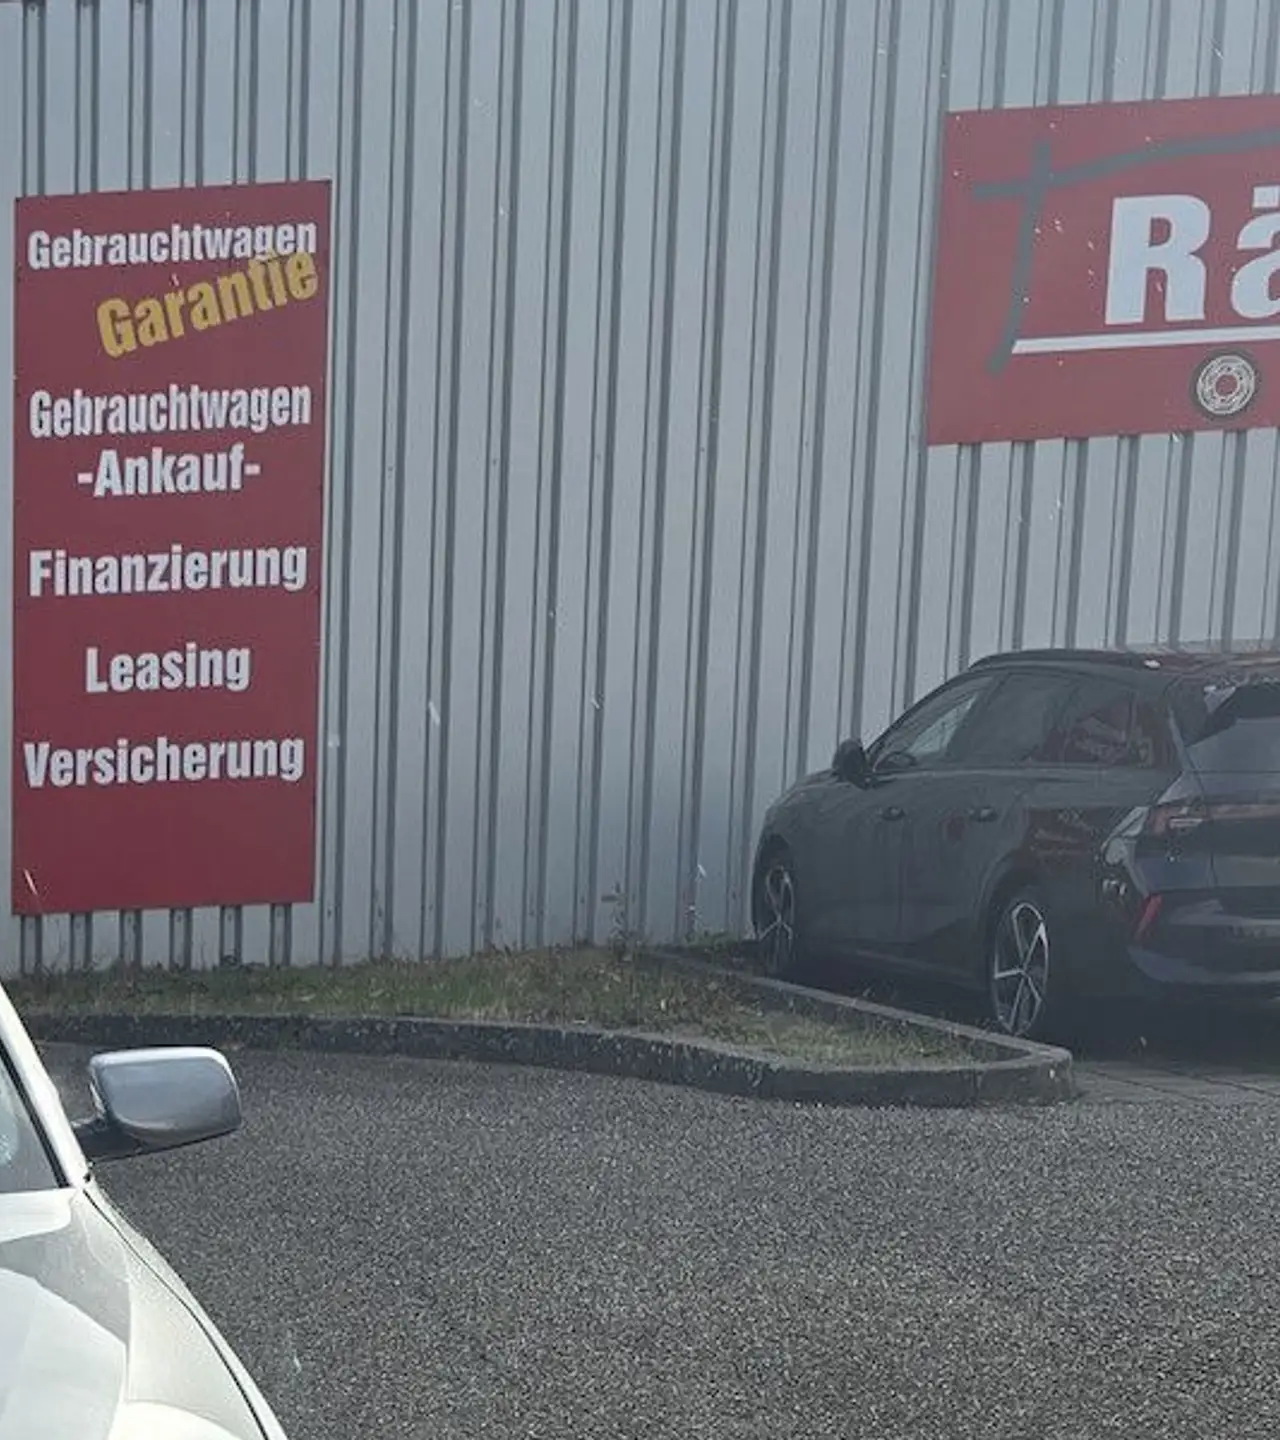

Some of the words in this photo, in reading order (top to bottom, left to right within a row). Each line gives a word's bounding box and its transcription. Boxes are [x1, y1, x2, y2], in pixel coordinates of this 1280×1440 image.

[28, 222, 317, 269] Gebrauchtwagen
[97, 251, 318, 358] Garantie
[29, 384, 312, 438] Gebrauchtwagen
[77, 443, 261, 497] -Ankauf-
[29, 545, 308, 597] Finanzierung
[85, 642, 252, 692] Leasing
[24, 736, 305, 788] Versicherung
